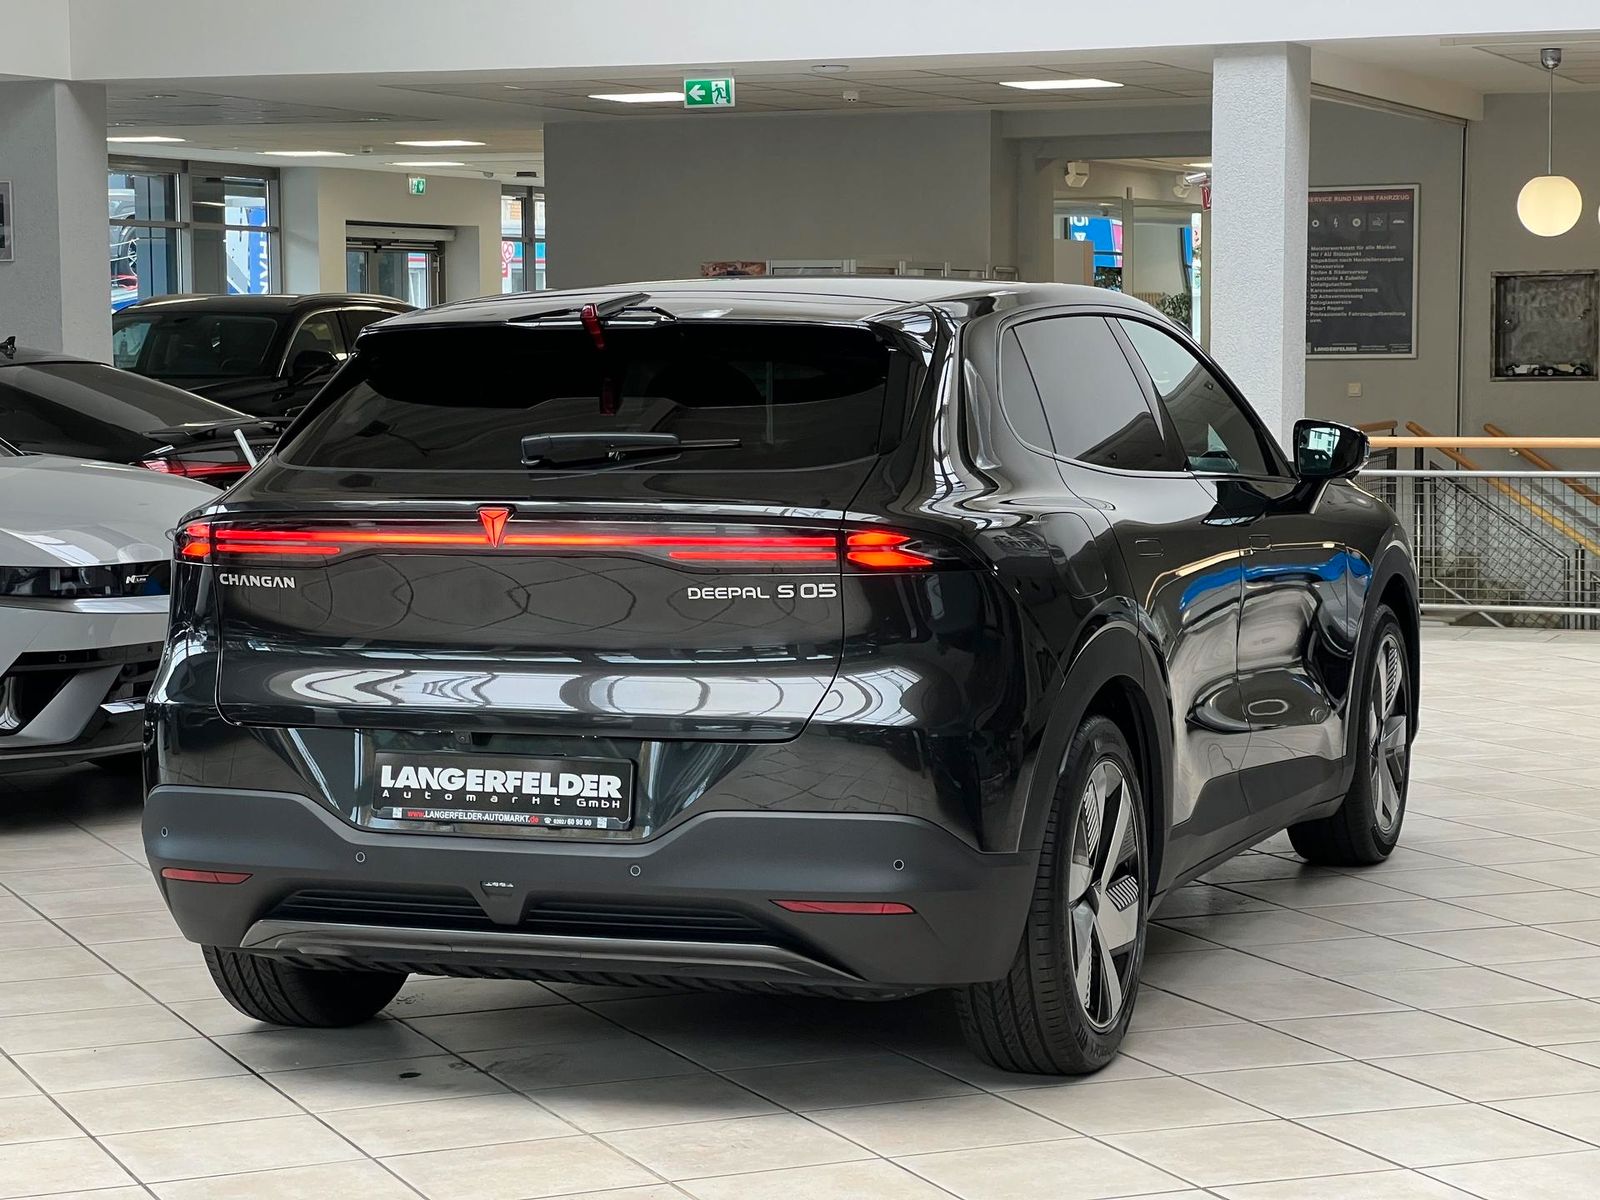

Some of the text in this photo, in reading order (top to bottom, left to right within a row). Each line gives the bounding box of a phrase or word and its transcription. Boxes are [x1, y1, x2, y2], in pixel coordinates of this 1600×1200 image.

[219, 573, 296, 589] CHANGAN
[687, 586, 770, 600] DEEPAL
[800, 583, 837, 599] 05
[380, 765, 623, 800] LANGERFELDER
[576, 798, 621, 809] GmbH
